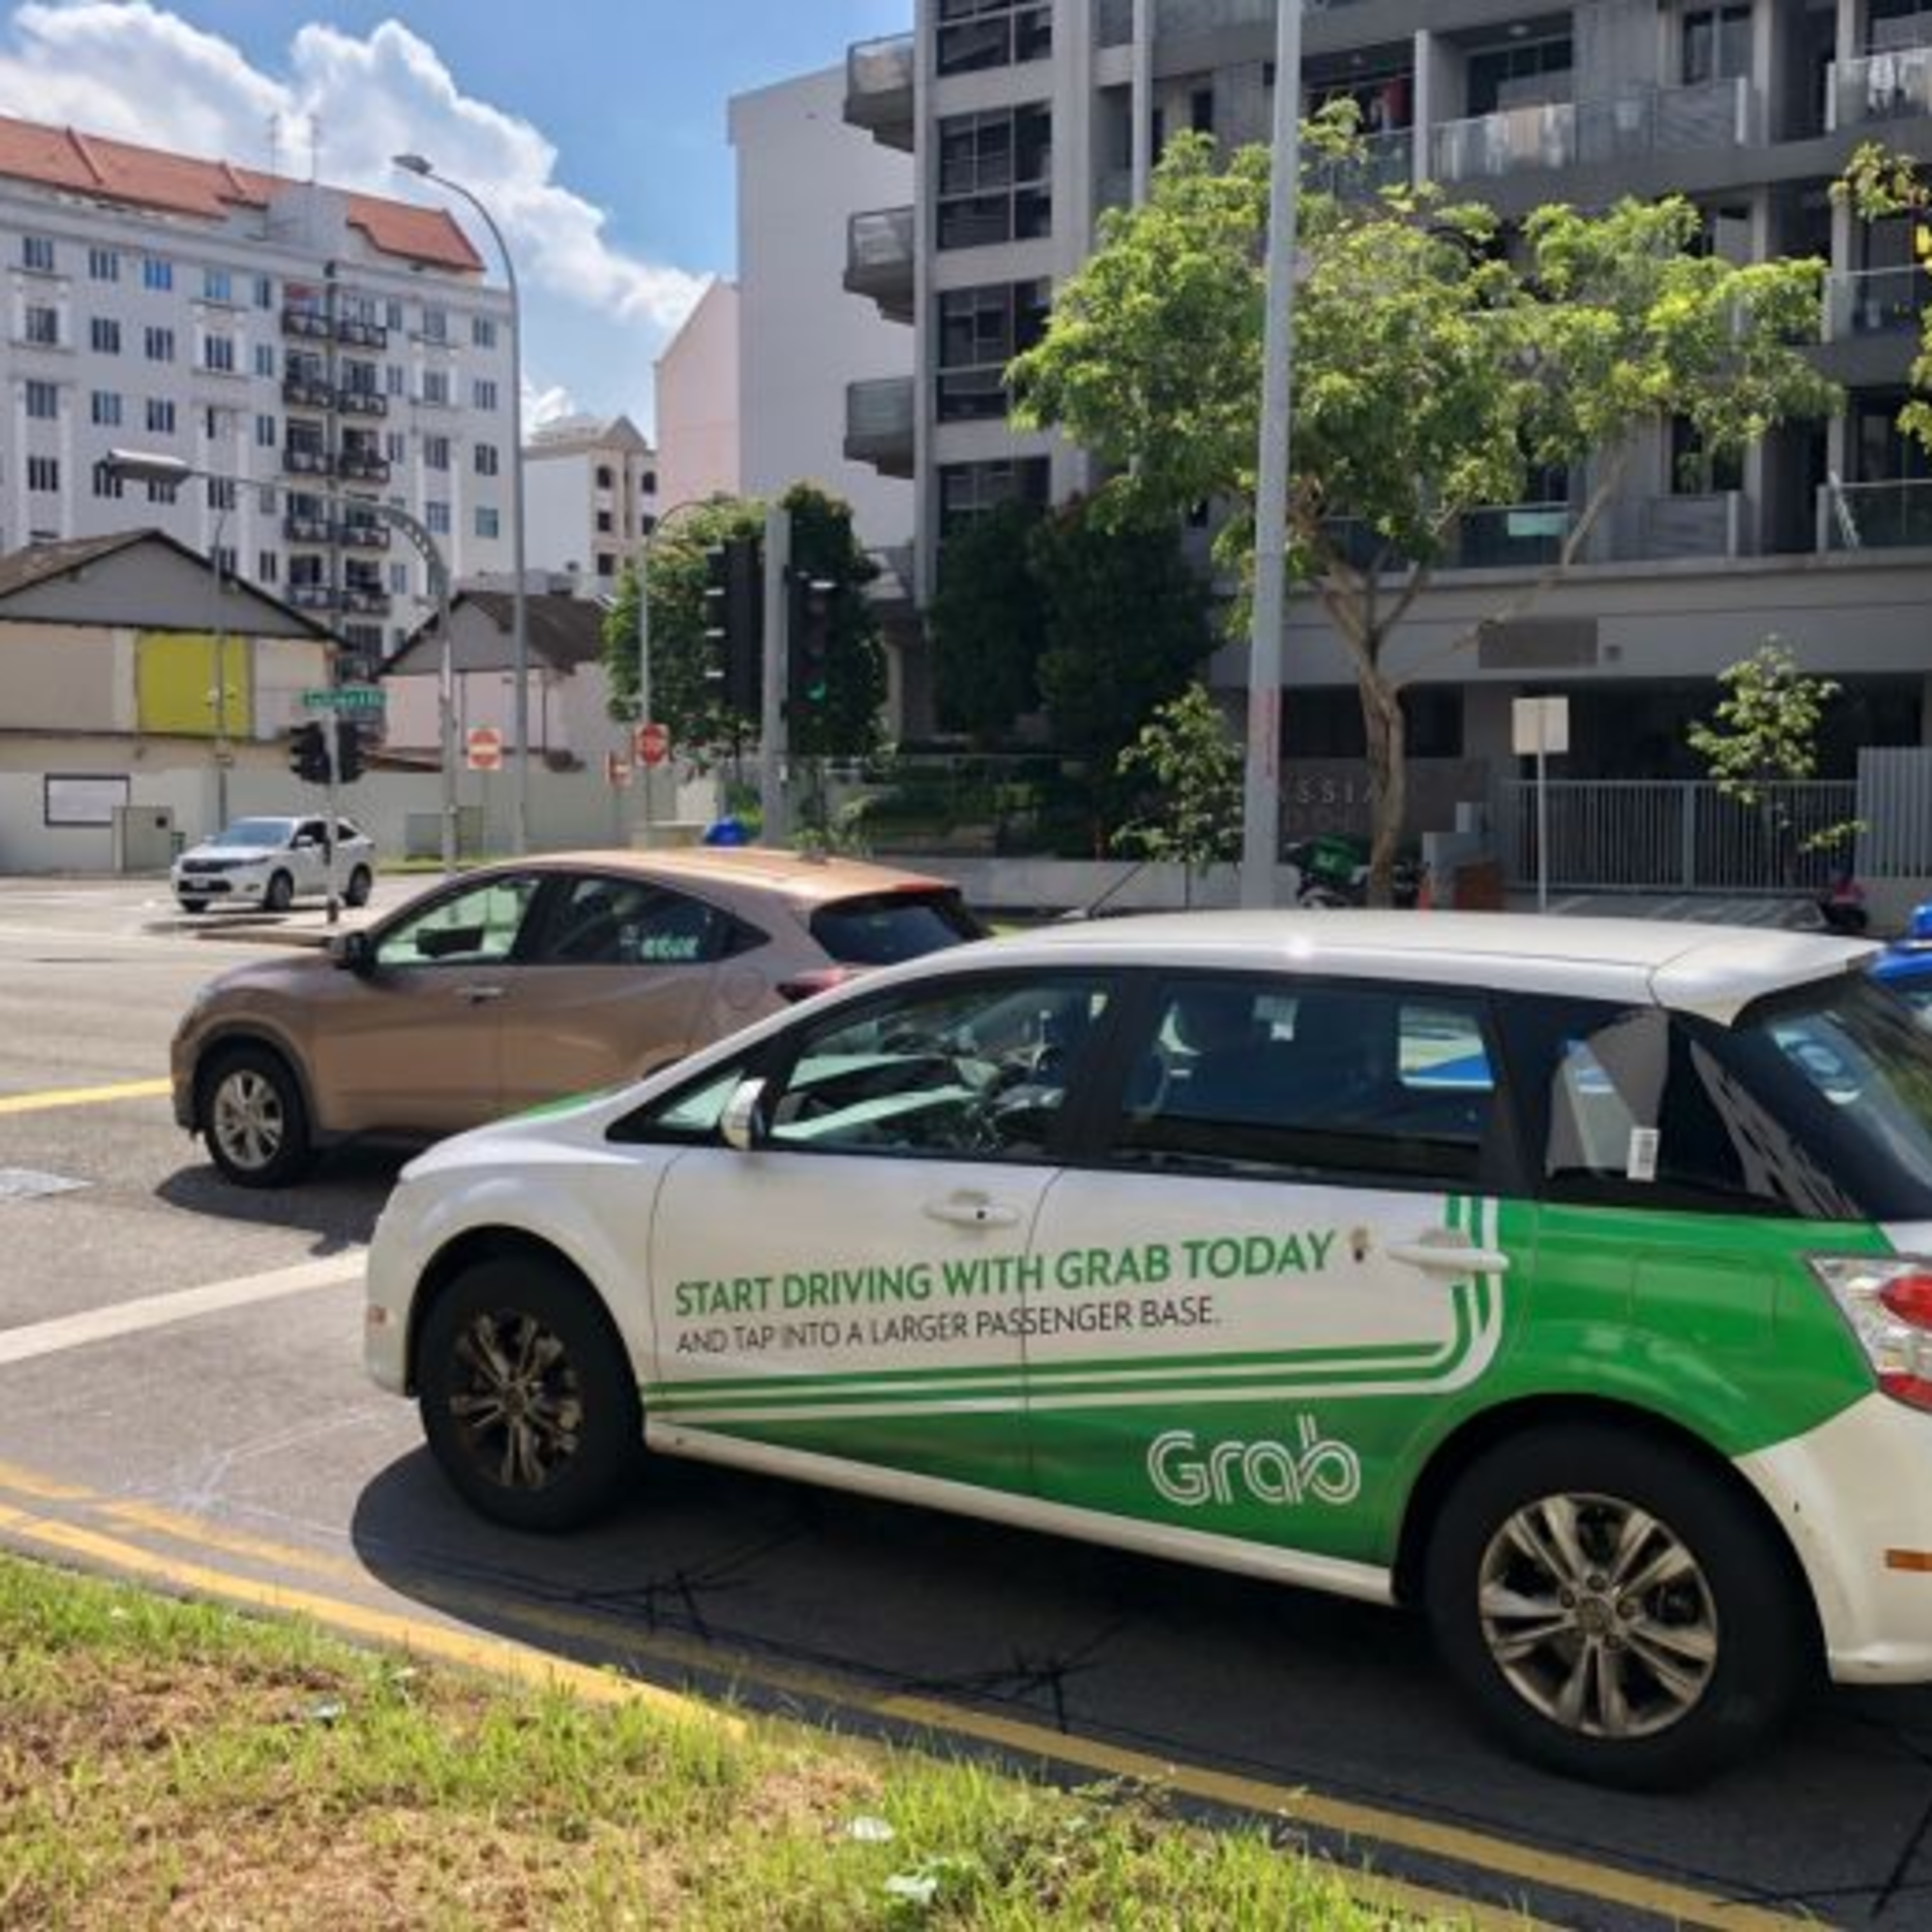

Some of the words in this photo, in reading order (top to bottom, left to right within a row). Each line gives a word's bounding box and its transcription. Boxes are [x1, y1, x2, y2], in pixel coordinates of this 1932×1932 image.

[676, 1277, 772, 1316] START
[782, 1263, 931, 1309] DRIVING
[942, 1255, 1043, 1297] WITH
[1055, 1244, 1170, 1289] GRAB
[1182, 1229, 1335, 1278] TODAY
[676, 1328, 728, 1354] AND
[735, 1325, 773, 1350] TAP
[782, 1321, 840, 1349] INTO
[846, 1322, 863, 1344] A
[871, 1311, 967, 1345] LARGER
[976, 1300, 1133, 1338] PASSENGER
[1148, 1415, 1360, 1506] Grab
